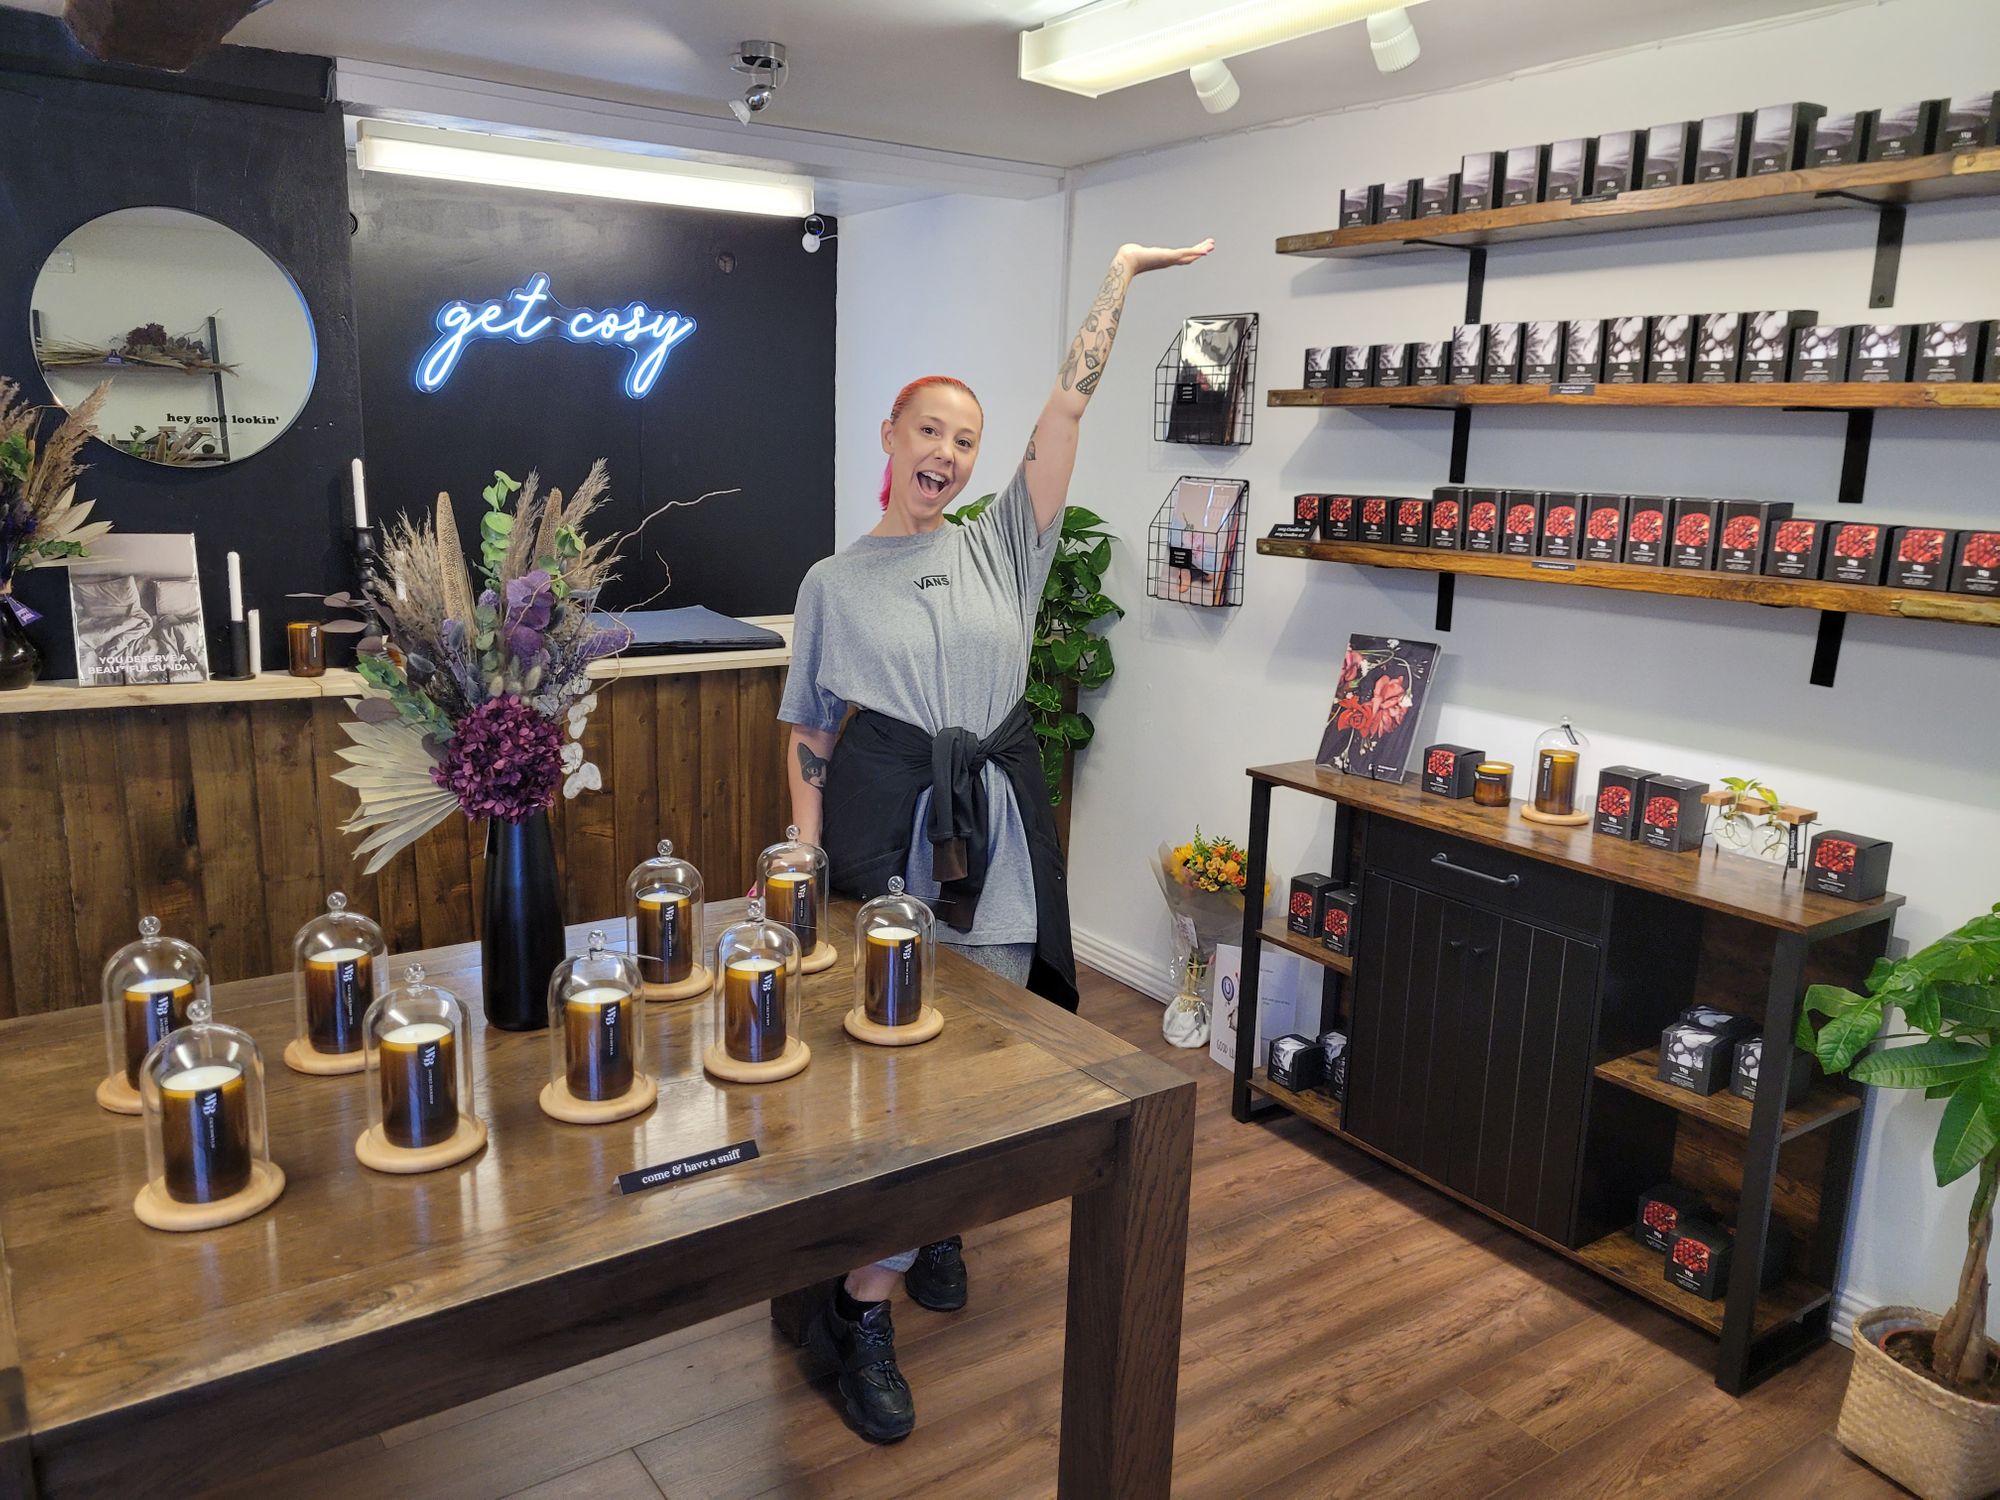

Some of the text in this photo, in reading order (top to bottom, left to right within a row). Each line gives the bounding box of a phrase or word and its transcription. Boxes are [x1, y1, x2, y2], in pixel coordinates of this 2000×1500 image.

[423, 278, 693, 394] get cosy
[166, 413, 279, 425] hey good lookin'
[913, 575, 950, 590] VANS
[99, 653, 188, 665] YOU DESERVE A
[152, 662, 197, 672] SUNDAY
[343, 963, 354, 982] WB
[156, 996, 169, 1016] WB
[605, 1006, 617, 1026] WB
[423, 1045, 436, 1068] WB
[203, 1092, 218, 1116] WB
[641, 1148, 741, 1184] come & have a sniff
